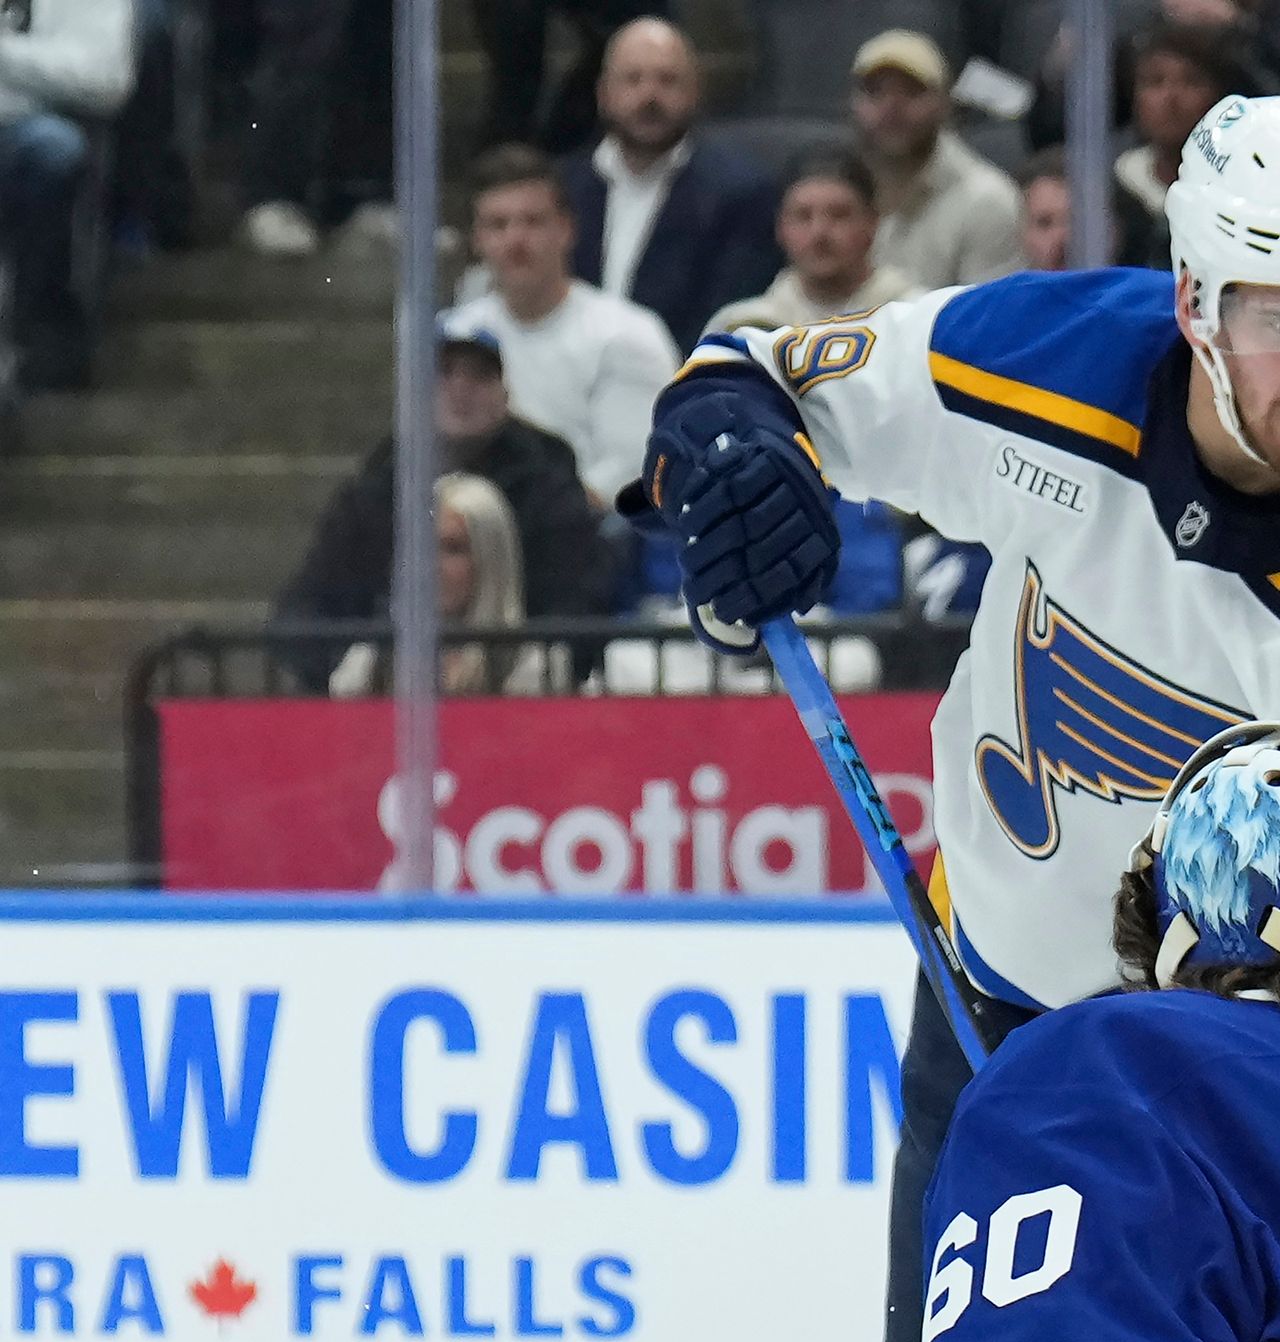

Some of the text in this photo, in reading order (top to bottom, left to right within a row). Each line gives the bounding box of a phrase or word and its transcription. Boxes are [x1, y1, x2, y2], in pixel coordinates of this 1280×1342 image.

[996, 446, 1084, 514] STIFEL
[377, 763, 829, 893] Scotia
[291, 1253, 638, 1339] FALLS
